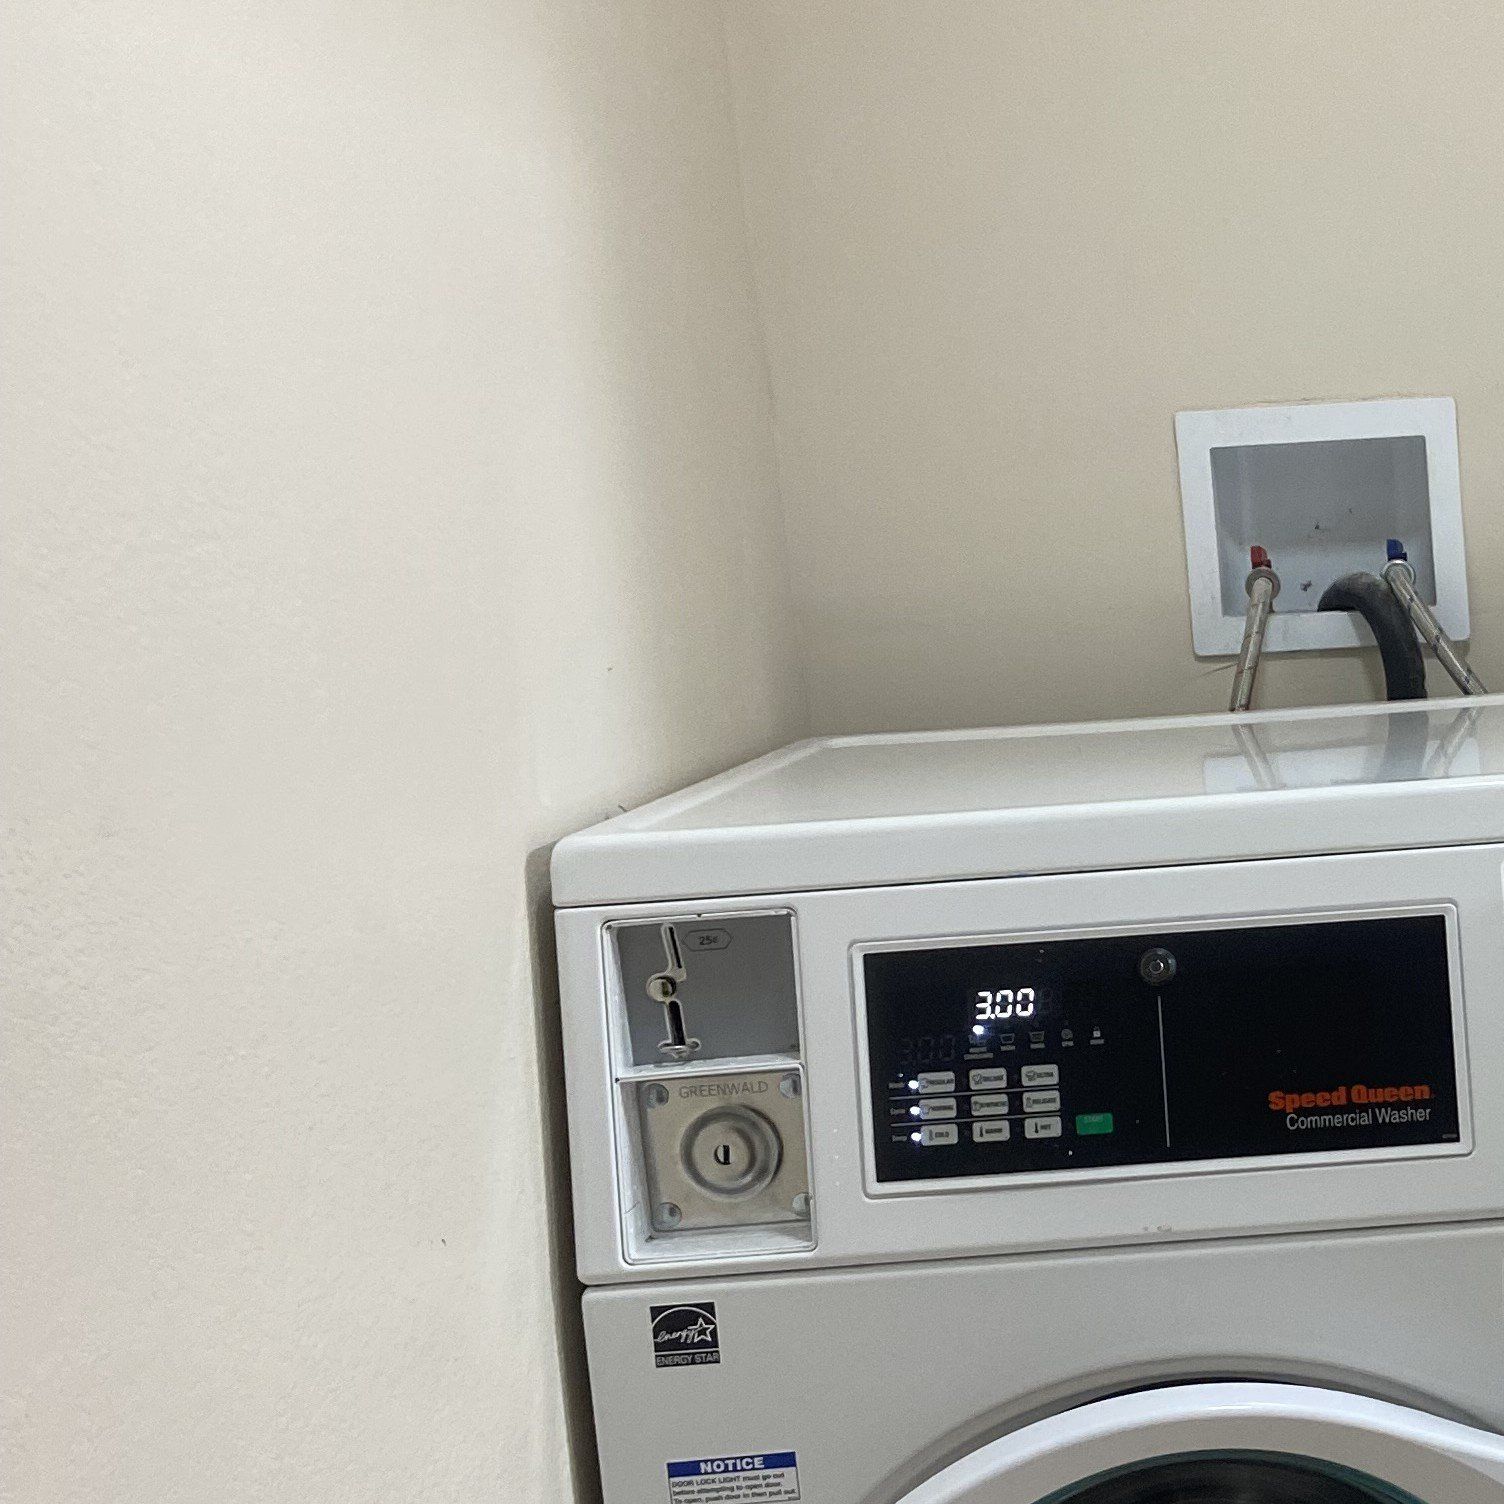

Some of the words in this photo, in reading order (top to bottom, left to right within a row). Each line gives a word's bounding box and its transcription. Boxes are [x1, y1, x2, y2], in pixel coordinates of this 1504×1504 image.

[975, 987, 1035, 1020] 3.00
[678, 1080, 770, 1100] GREENWALD
[1268, 1086, 1348, 1113] Speed
[1350, 1083, 1431, 1104] Queen
[1286, 1108, 1373, 1131] Commercial
[1375, 1106, 1432, 1124] Washer
[656, 1354, 693, 1367] ENERGY
[694, 1352, 720, 1363] STAR
[699, 1457, 765, 1474] NOTICE
[695, 1479, 717, 1487] LOCK
[718, 1476, 741, 1485] LIGHT
[761, 1474, 772, 1482] go
[696, 1486, 736, 1494] attempting
